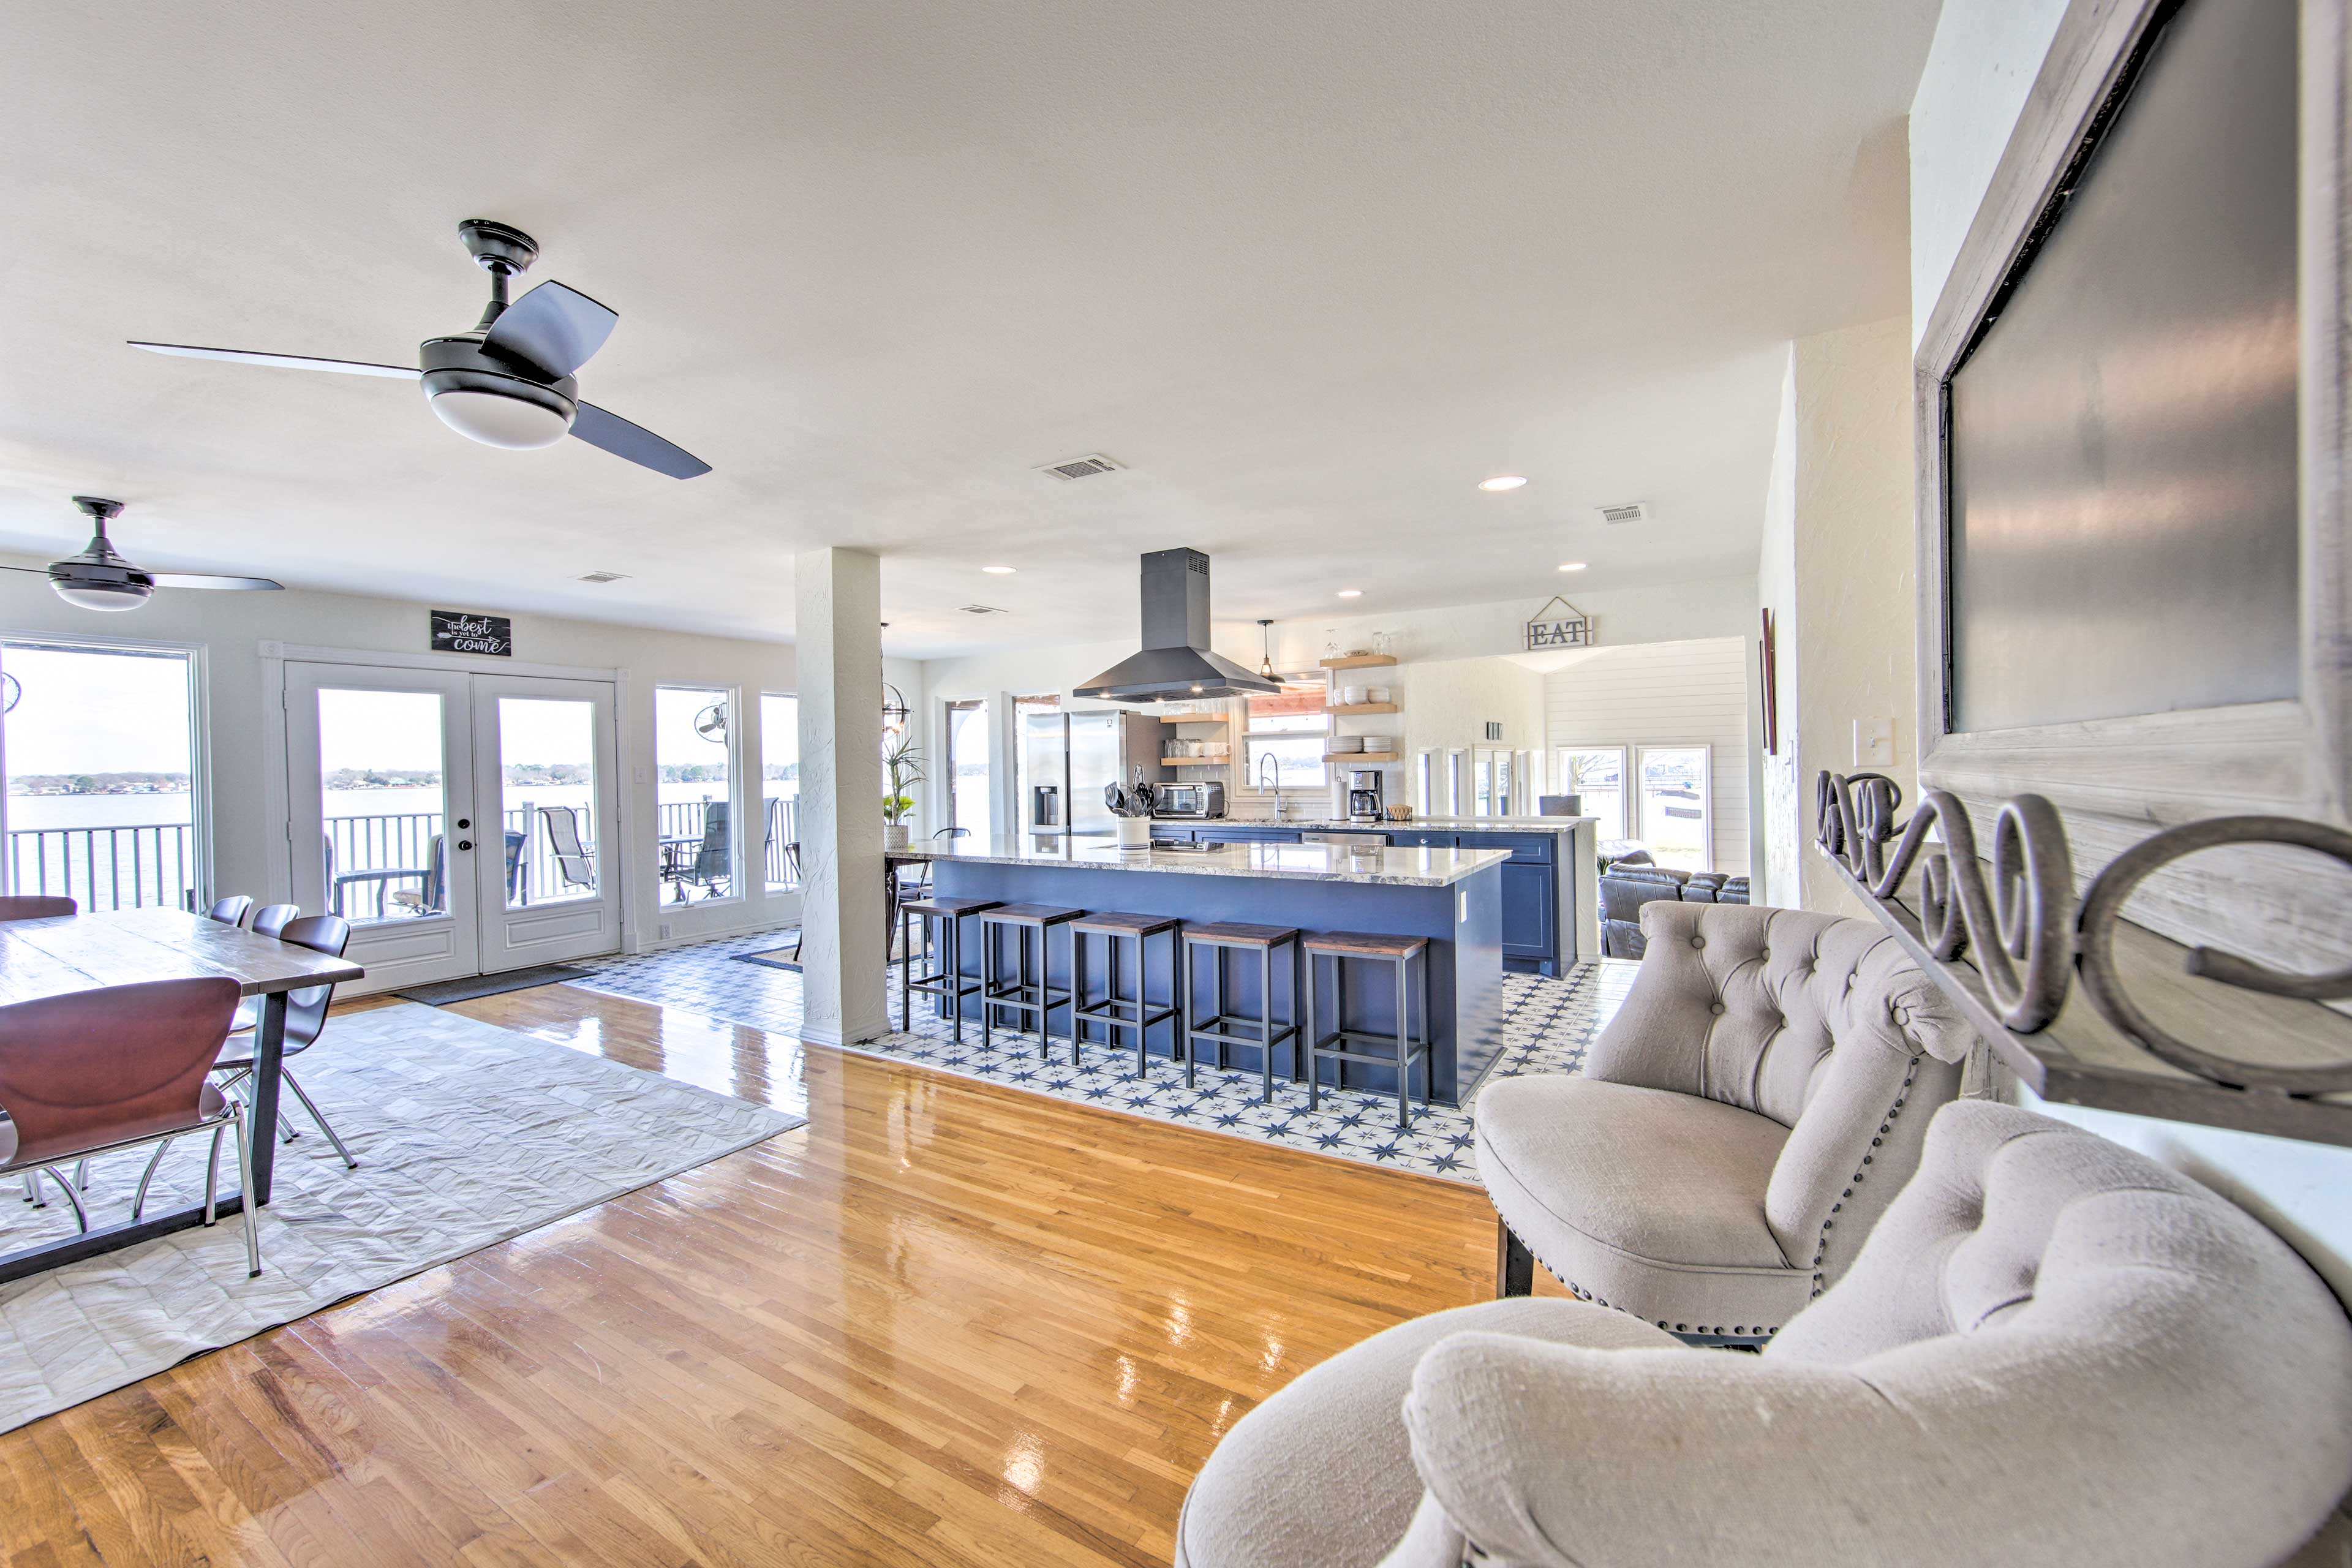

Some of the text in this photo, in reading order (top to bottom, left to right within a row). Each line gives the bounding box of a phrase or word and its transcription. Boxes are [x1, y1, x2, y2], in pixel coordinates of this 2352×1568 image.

[460, 615, 492, 635] best
[1531, 620, 1583, 646] EAT
[454, 639, 510, 654] come
